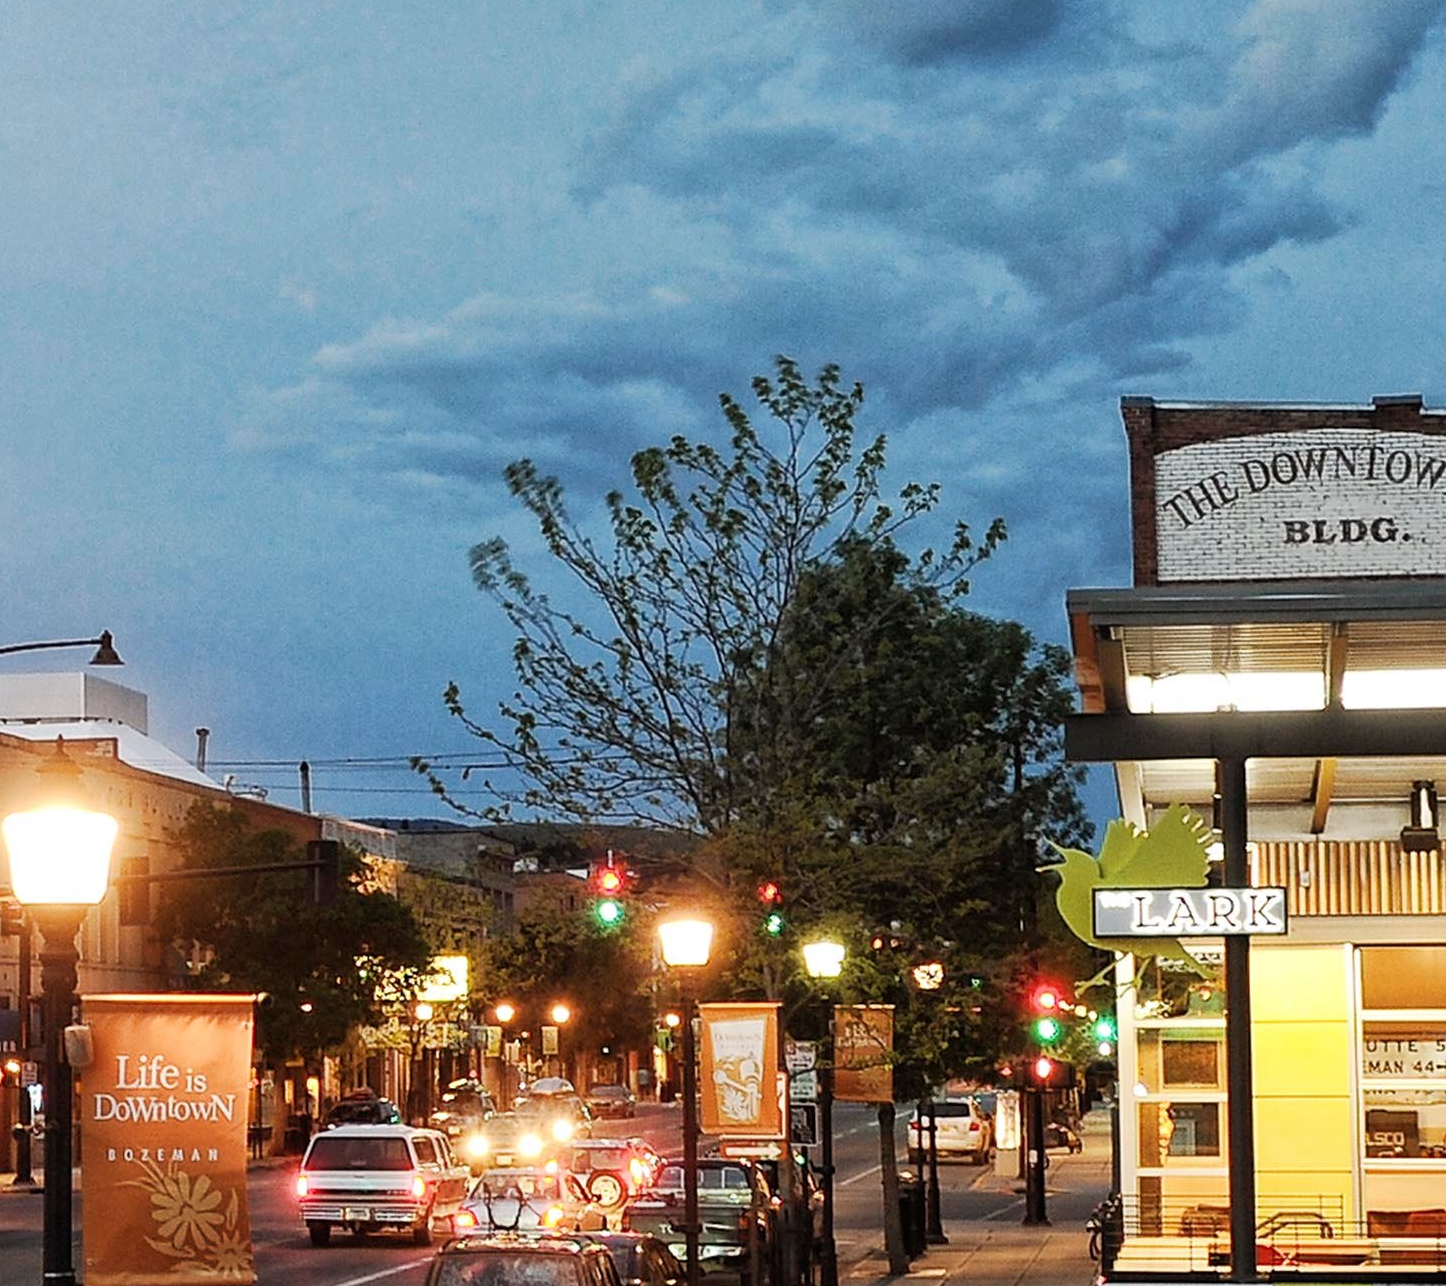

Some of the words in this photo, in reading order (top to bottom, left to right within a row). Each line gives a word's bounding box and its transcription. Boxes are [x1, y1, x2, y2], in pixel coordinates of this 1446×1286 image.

[1162, 470, 1240, 529] THE
[1282, 517, 1411, 545] BLDG.
[1133, 894, 1280, 930] LARK
[1364, 1039, 1419, 1053] UTTE
[115, 1055, 180, 1090] Life
[185, 1067, 208, 1093] is
[1364, 1060, 1404, 1074] MAN
[1413, 1060, 1435, 1073] 44
[108, 1148, 218, 1162] BOZEMAN
